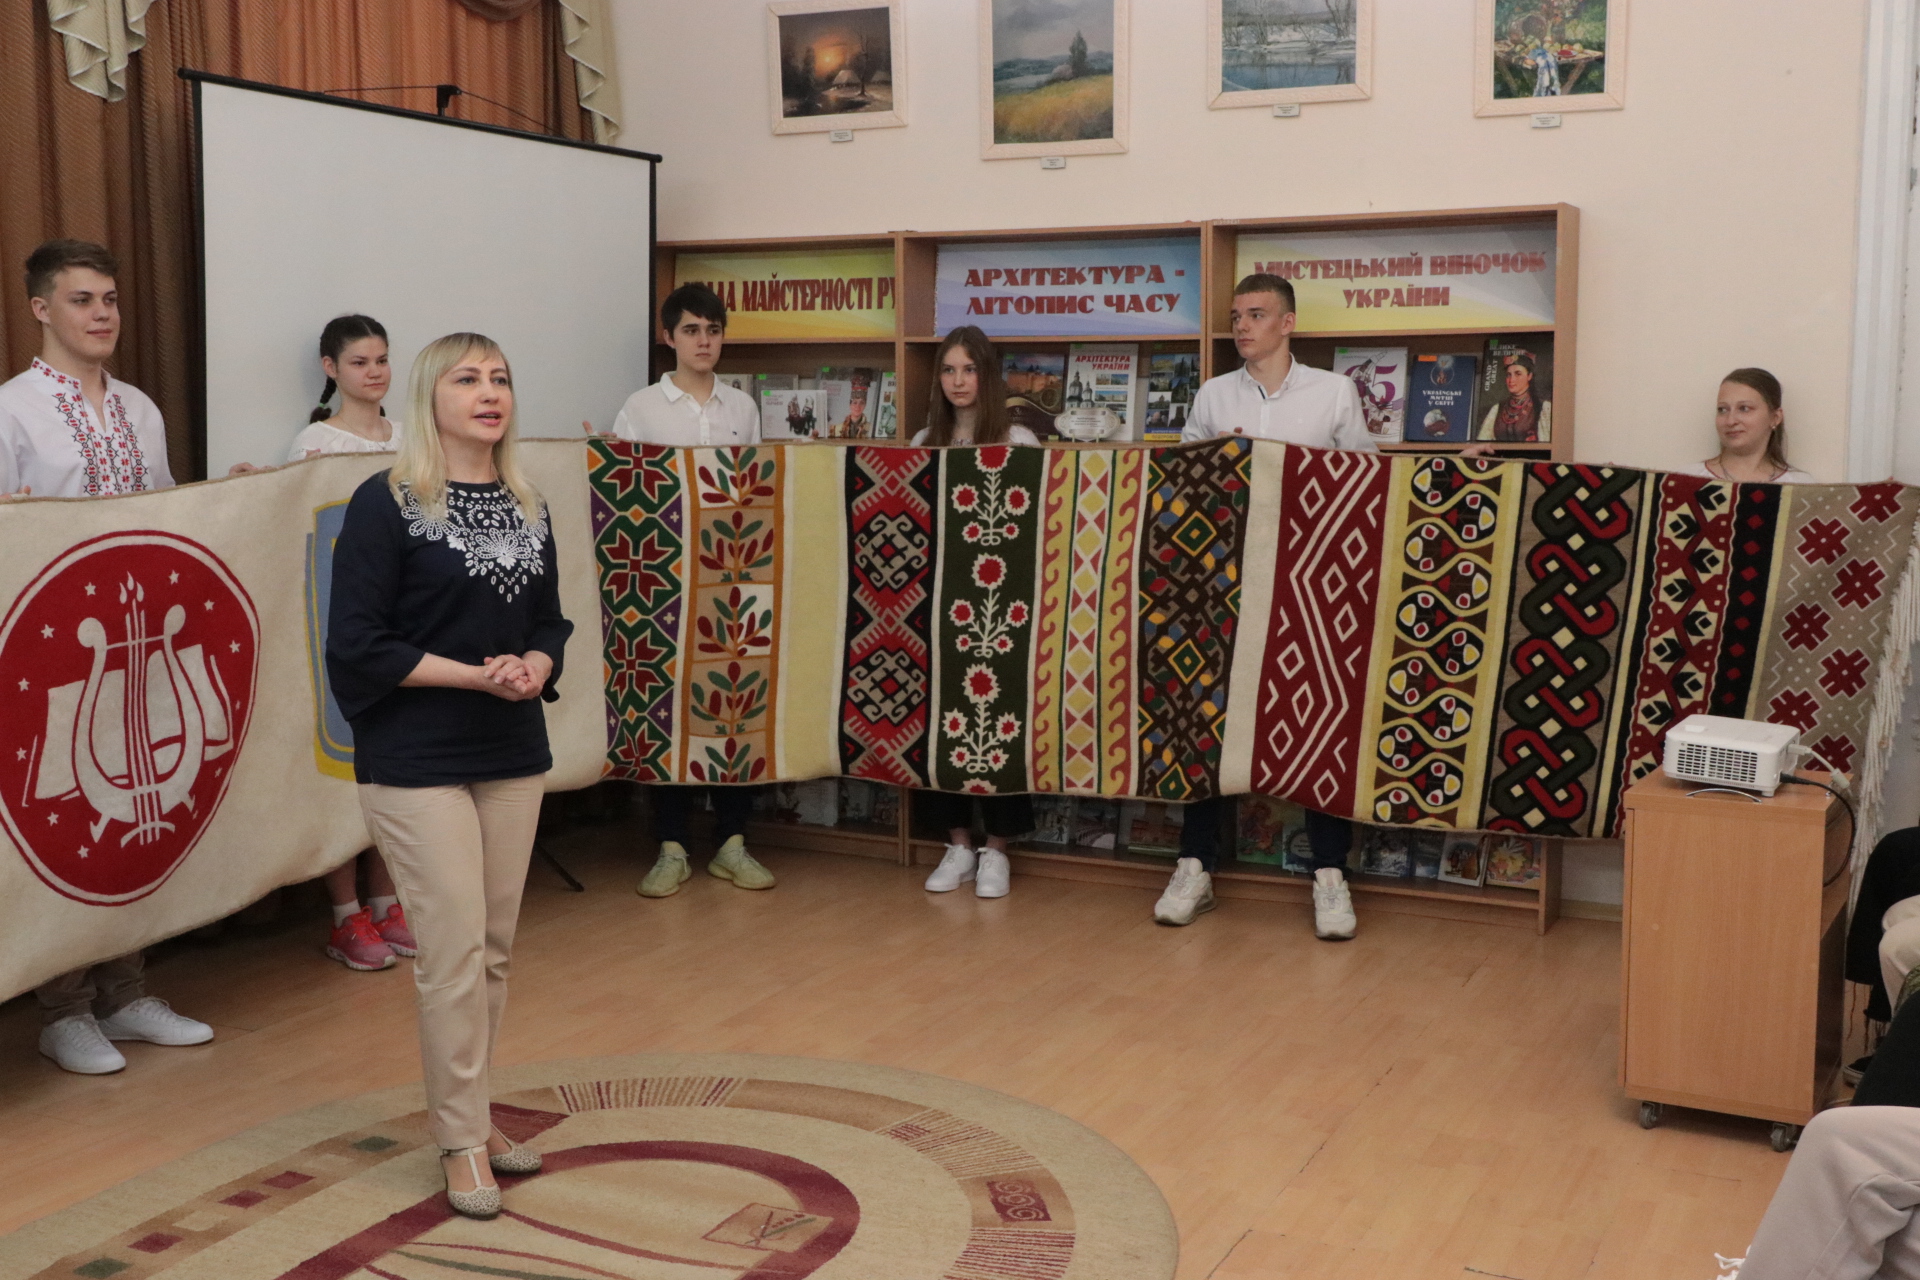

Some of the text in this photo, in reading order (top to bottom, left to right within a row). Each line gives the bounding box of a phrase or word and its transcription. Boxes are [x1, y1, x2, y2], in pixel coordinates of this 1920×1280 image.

[964, 265, 1185, 287] АРХІТЕКТУРА -
[1254, 251, 1547, 283] МИСТЕЦЬКИЙ ВІНОЧОК
[742, 272, 873, 312] МАЙСТЕРНОСТІ
[1343, 284, 1450, 309] УКРАЇНИ
[966, 294, 1181, 315] ЛІТОПИС ЧАСУ
[1075, 355, 1131, 363] АРХІТЕКТУРА
[1092, 363, 1131, 371] УКРАЇНИ
